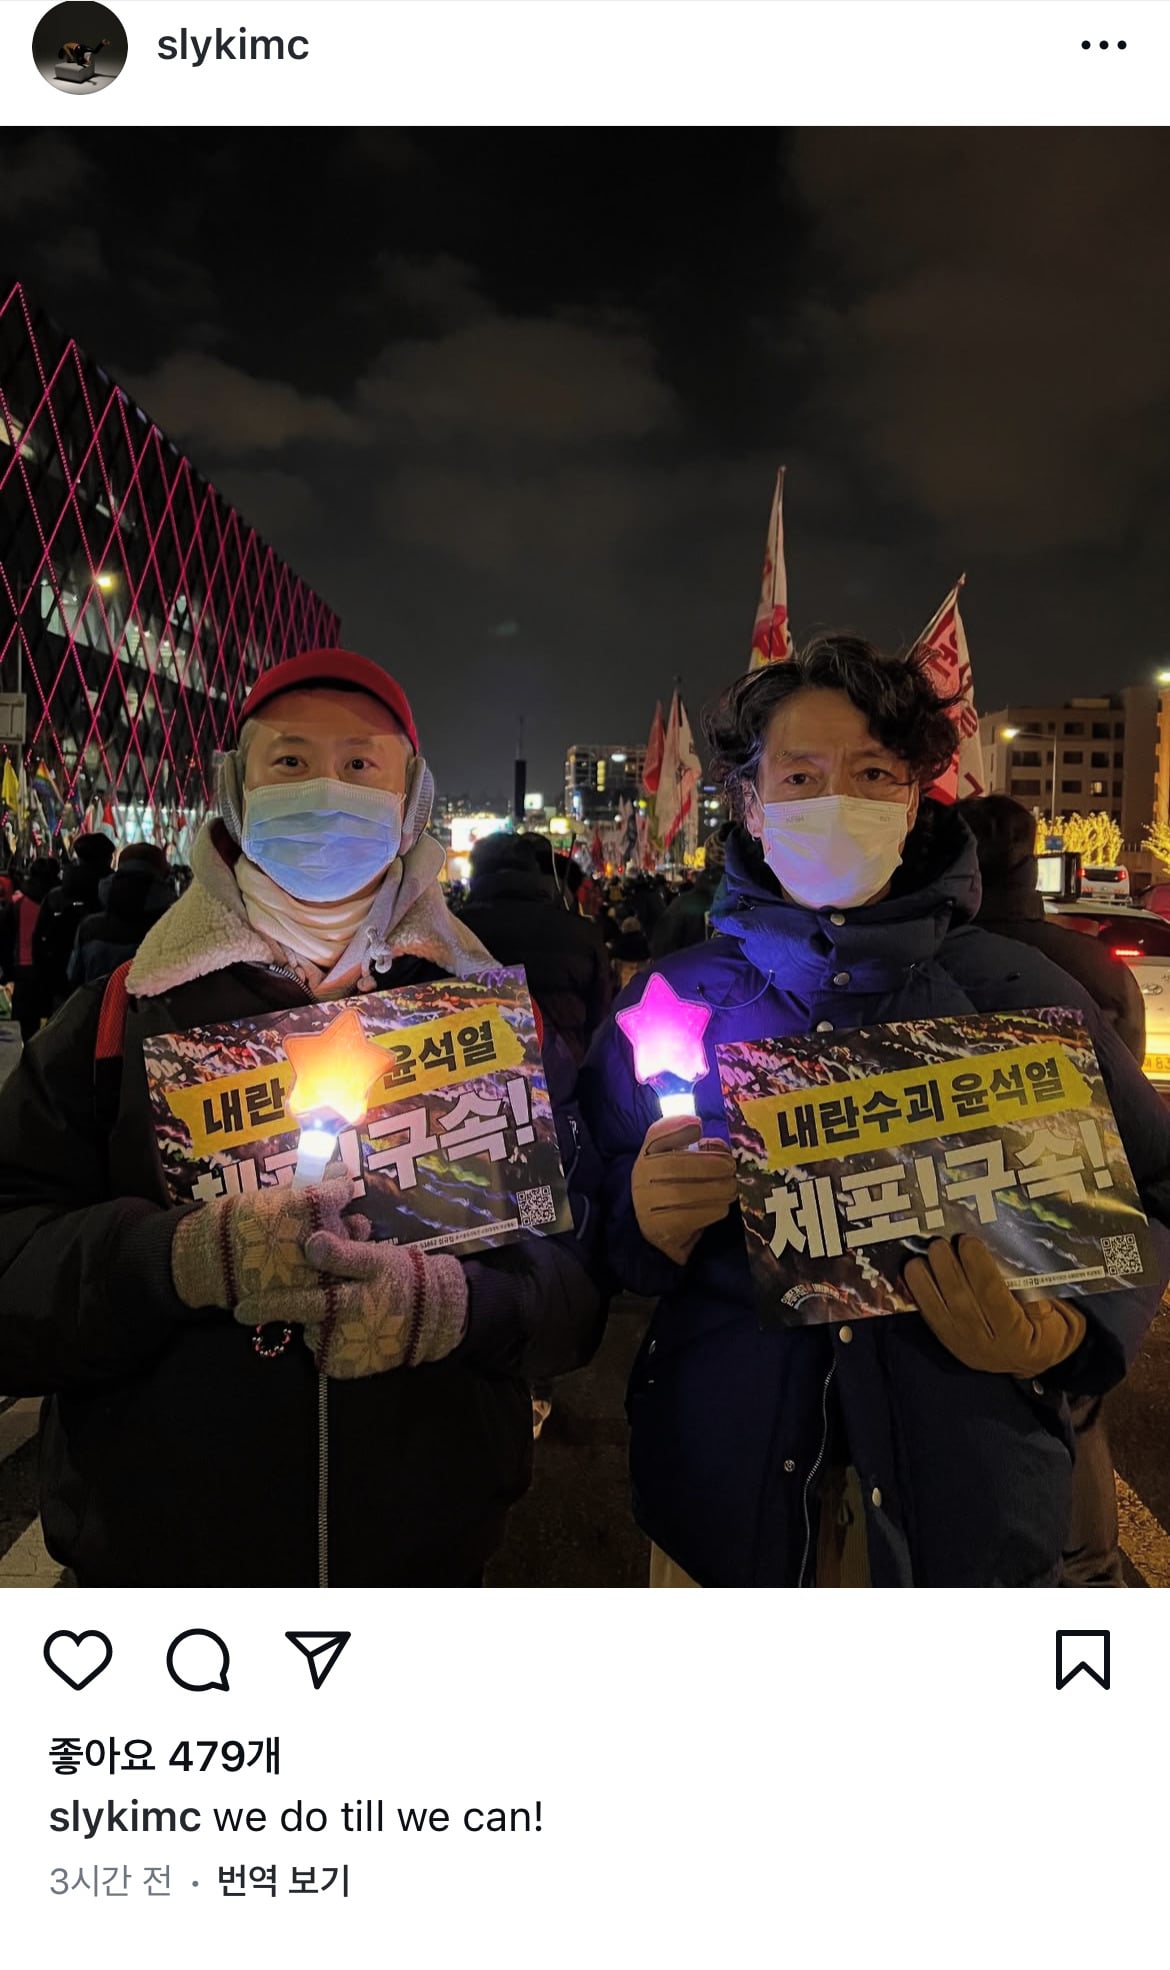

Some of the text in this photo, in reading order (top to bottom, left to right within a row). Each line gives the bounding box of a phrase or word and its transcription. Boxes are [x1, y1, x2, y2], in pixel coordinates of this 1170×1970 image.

[202, 1019, 498, 1136] 내란 윤석열
[776, 1056, 1066, 1149] 내란수괴 윤석열
